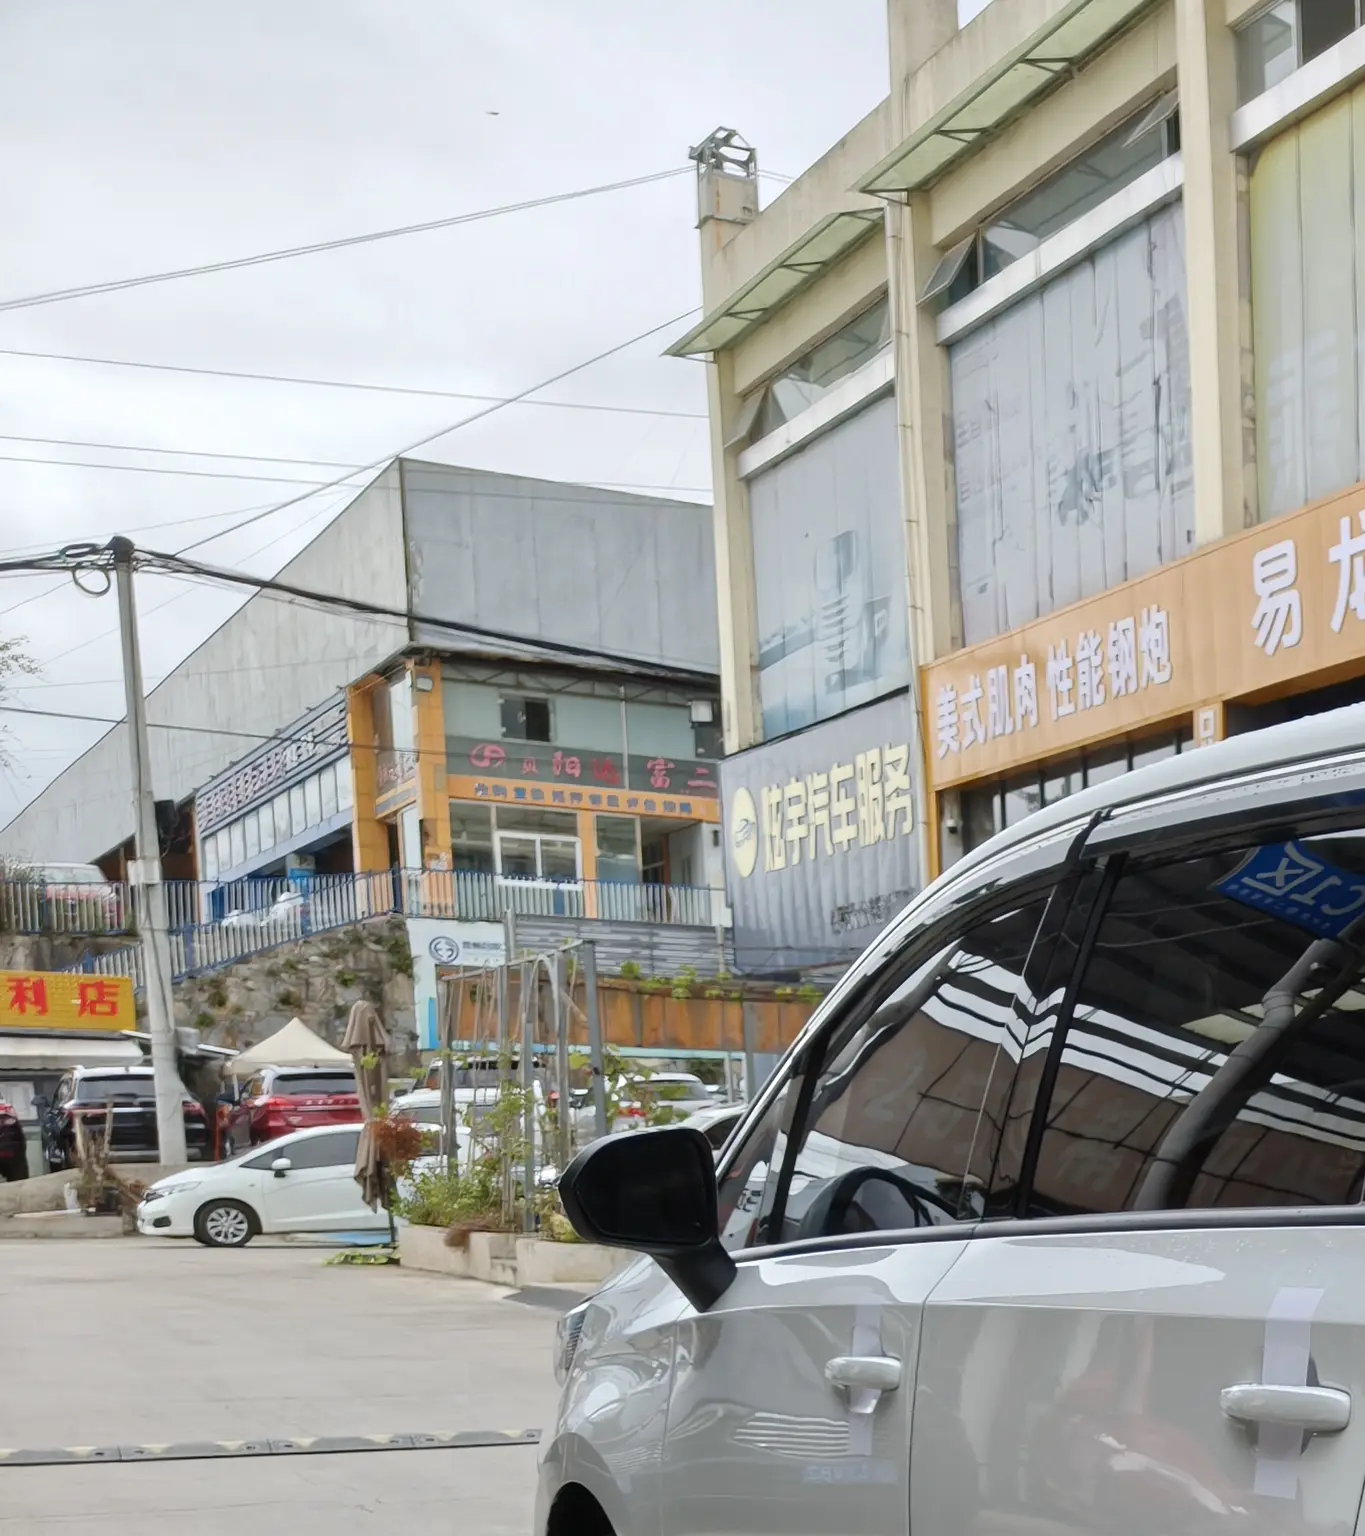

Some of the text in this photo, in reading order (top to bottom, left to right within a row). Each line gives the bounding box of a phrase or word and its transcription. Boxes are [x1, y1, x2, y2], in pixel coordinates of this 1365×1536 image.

[936, 604, 1172, 760] 美式肌肉 性能钢炮
[6, 976, 120, 1017] 利店
